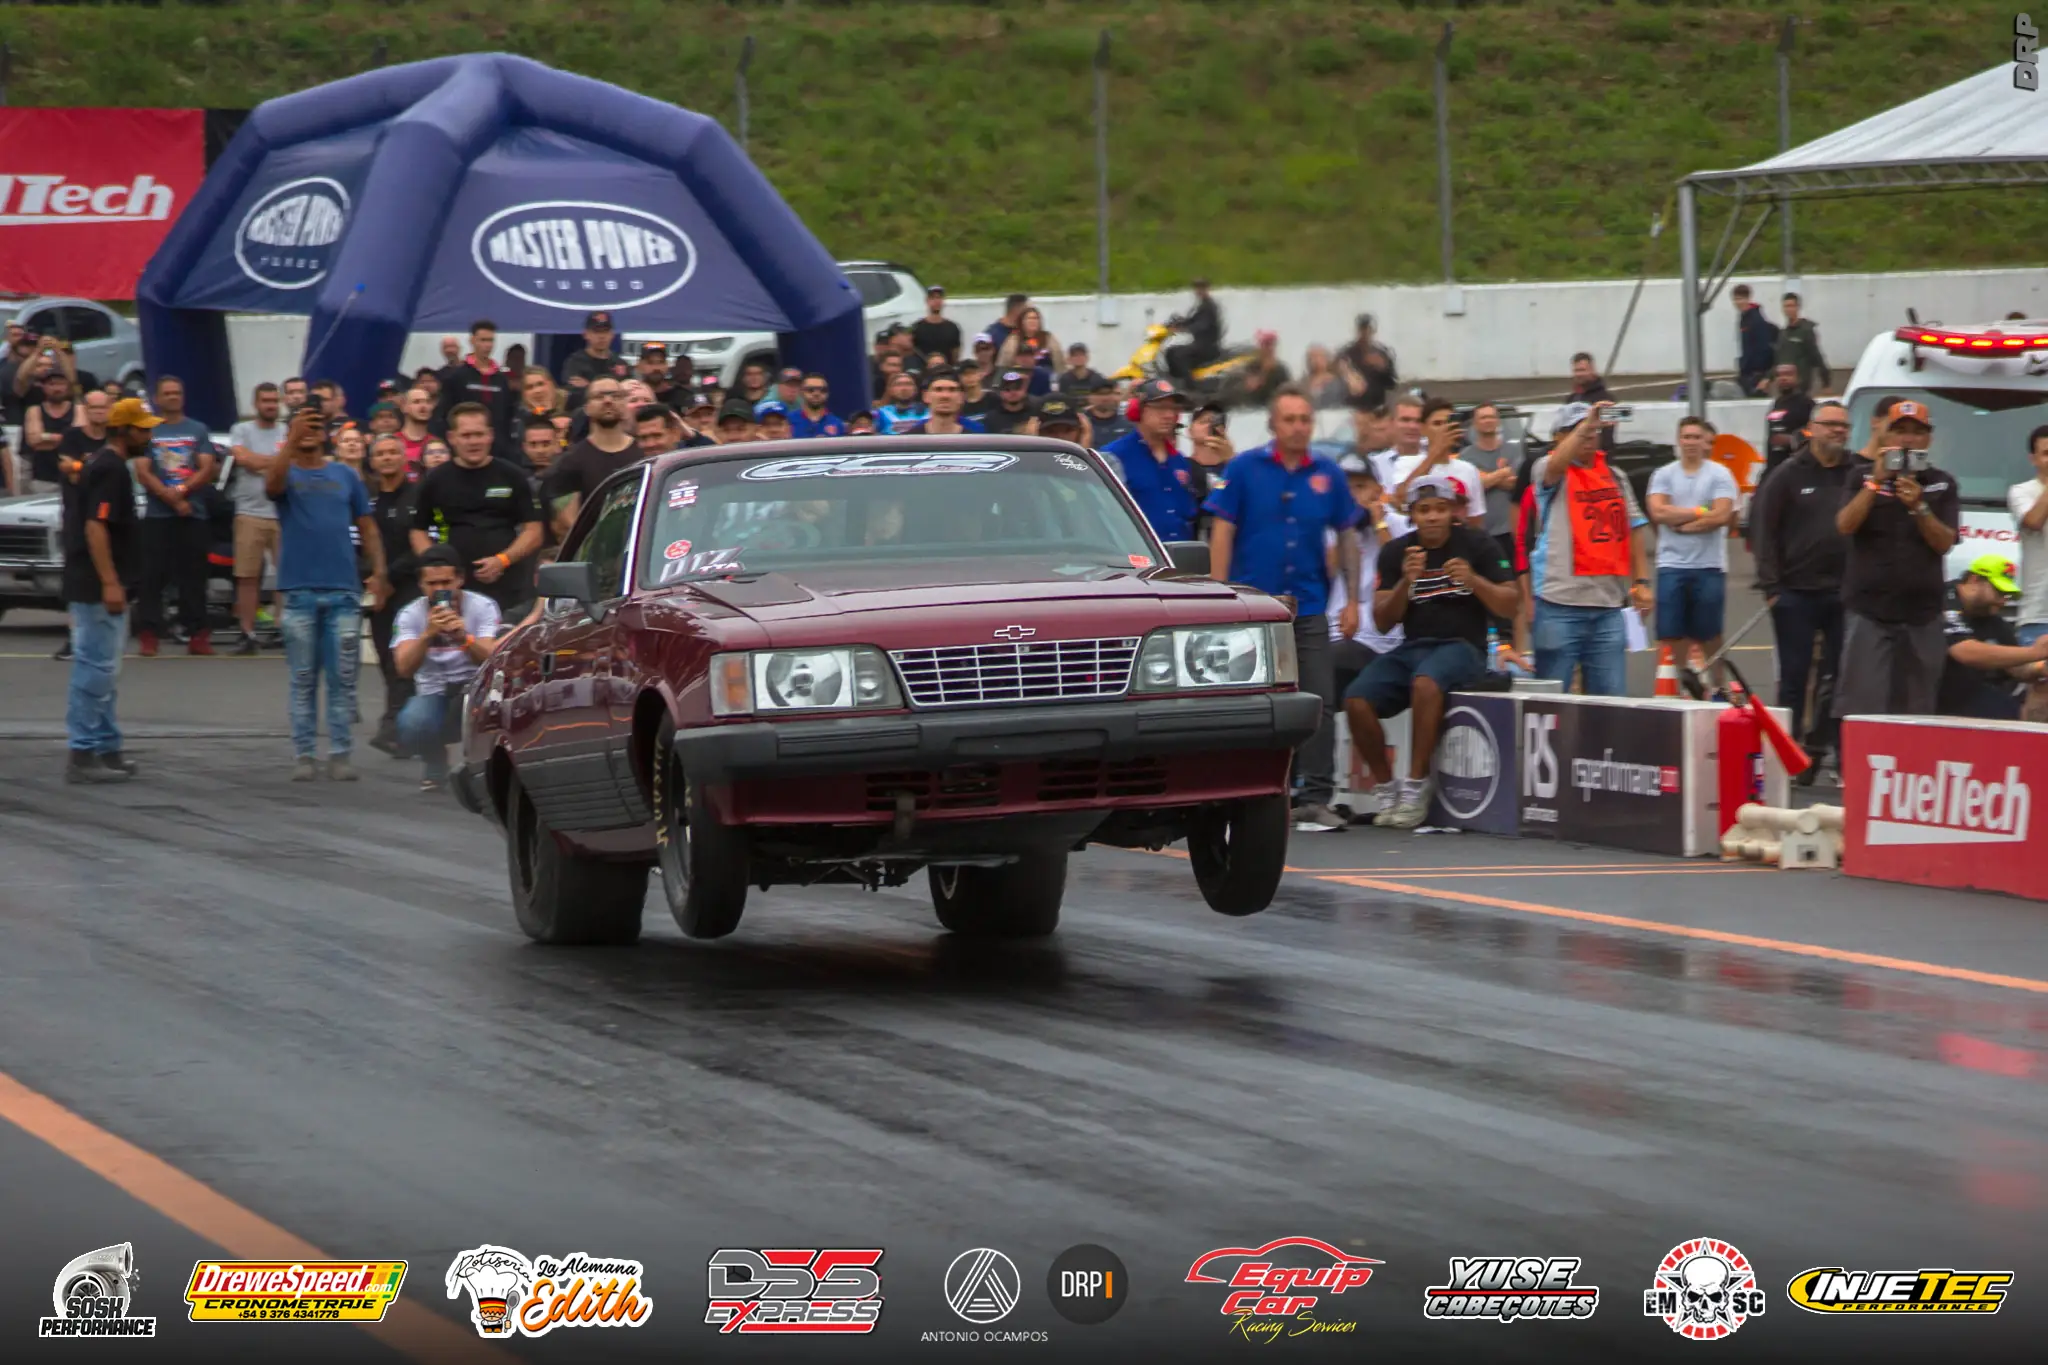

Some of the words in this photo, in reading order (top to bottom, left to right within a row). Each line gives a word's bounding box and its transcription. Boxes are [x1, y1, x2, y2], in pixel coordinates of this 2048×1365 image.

[489, 219, 586, 270] MASTER
[583, 219, 677, 269] POWER
[534, 279, 644, 290] TURBO
[1523, 712, 1559, 798] RS
[1866, 754, 2031, 843] FuelTech
